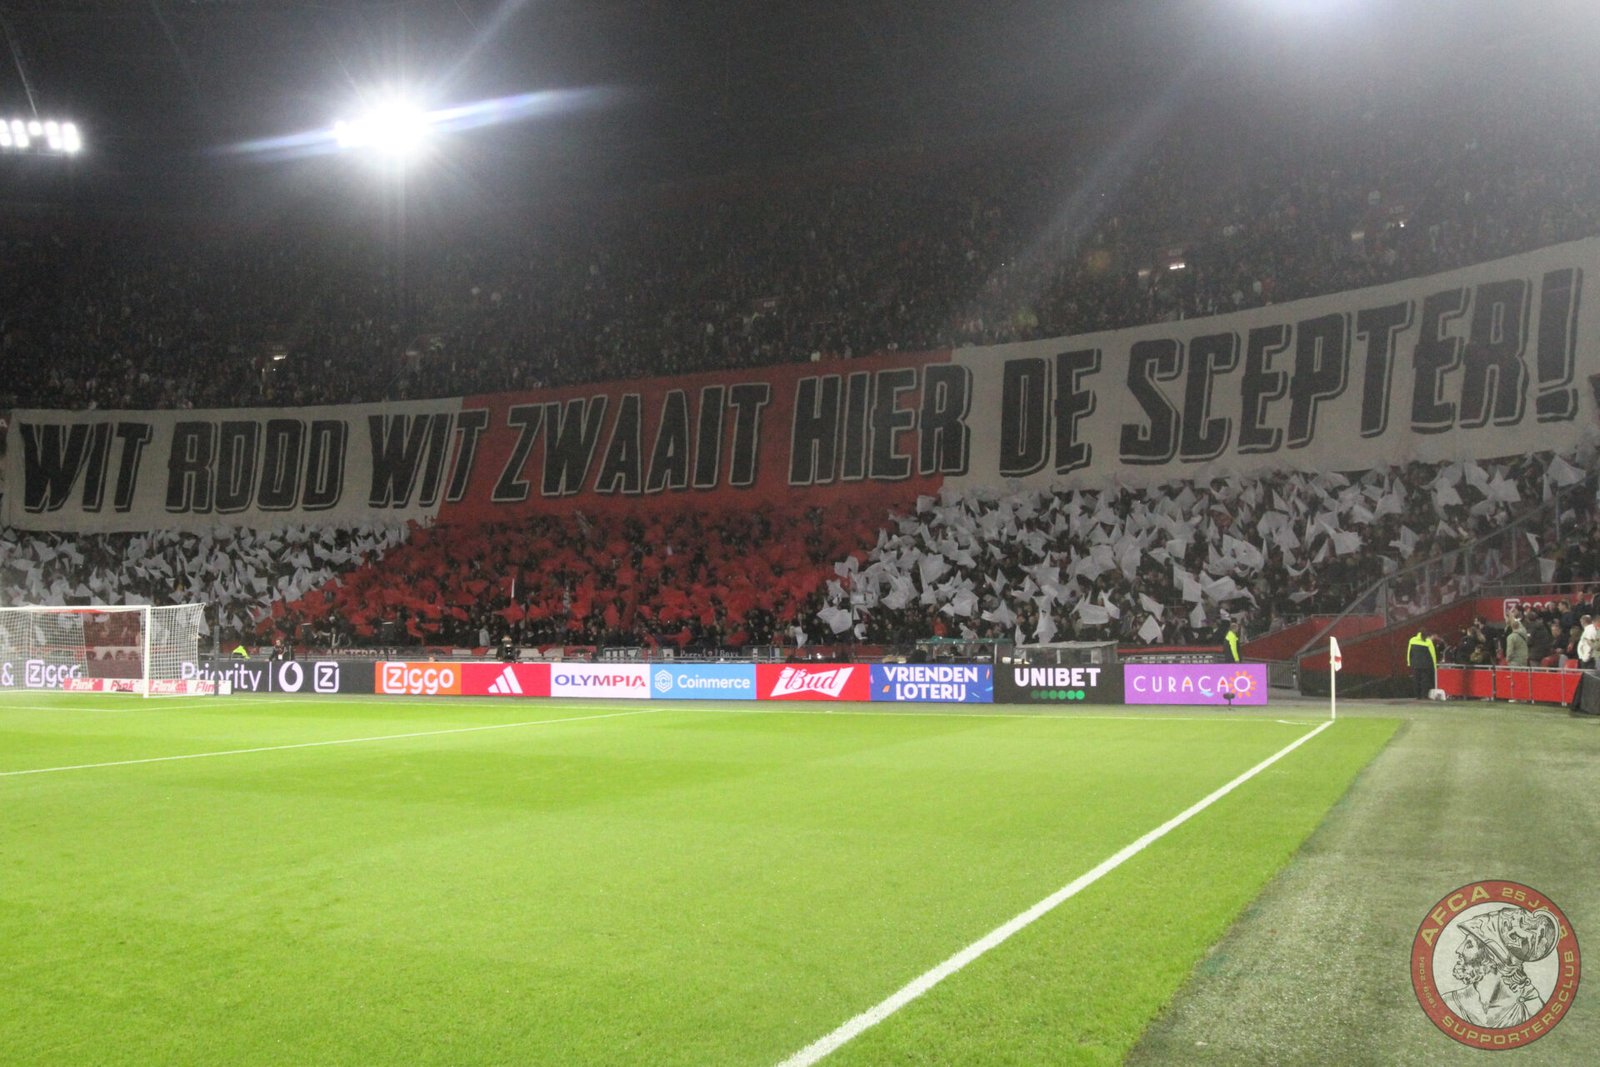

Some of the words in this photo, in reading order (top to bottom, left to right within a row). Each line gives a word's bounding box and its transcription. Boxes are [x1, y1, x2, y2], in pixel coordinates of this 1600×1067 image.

[20, 422, 152, 513] WIT
[165, 419, 349, 514] ROOD
[368, 408, 489, 509] WIT
[491, 382, 771, 503] ZWAAIT
[788, 362, 975, 488] HIER
[999, 348, 1101, 478] DE
[1119, 267, 1583, 466] SCEPTER!
[383, 662, 454, 694] Ziggo
[554, 674, 646, 688] OLYMPIA
[677, 674, 750, 689] Coinmerce
[780, 666, 839, 690] Bud
[883, 666, 978, 683] VRIENDEN
[1014, 667, 1101, 687] UNIBET
[195, 682, 220, 692] Flin
[895, 683, 966, 701] LOTERIJ
